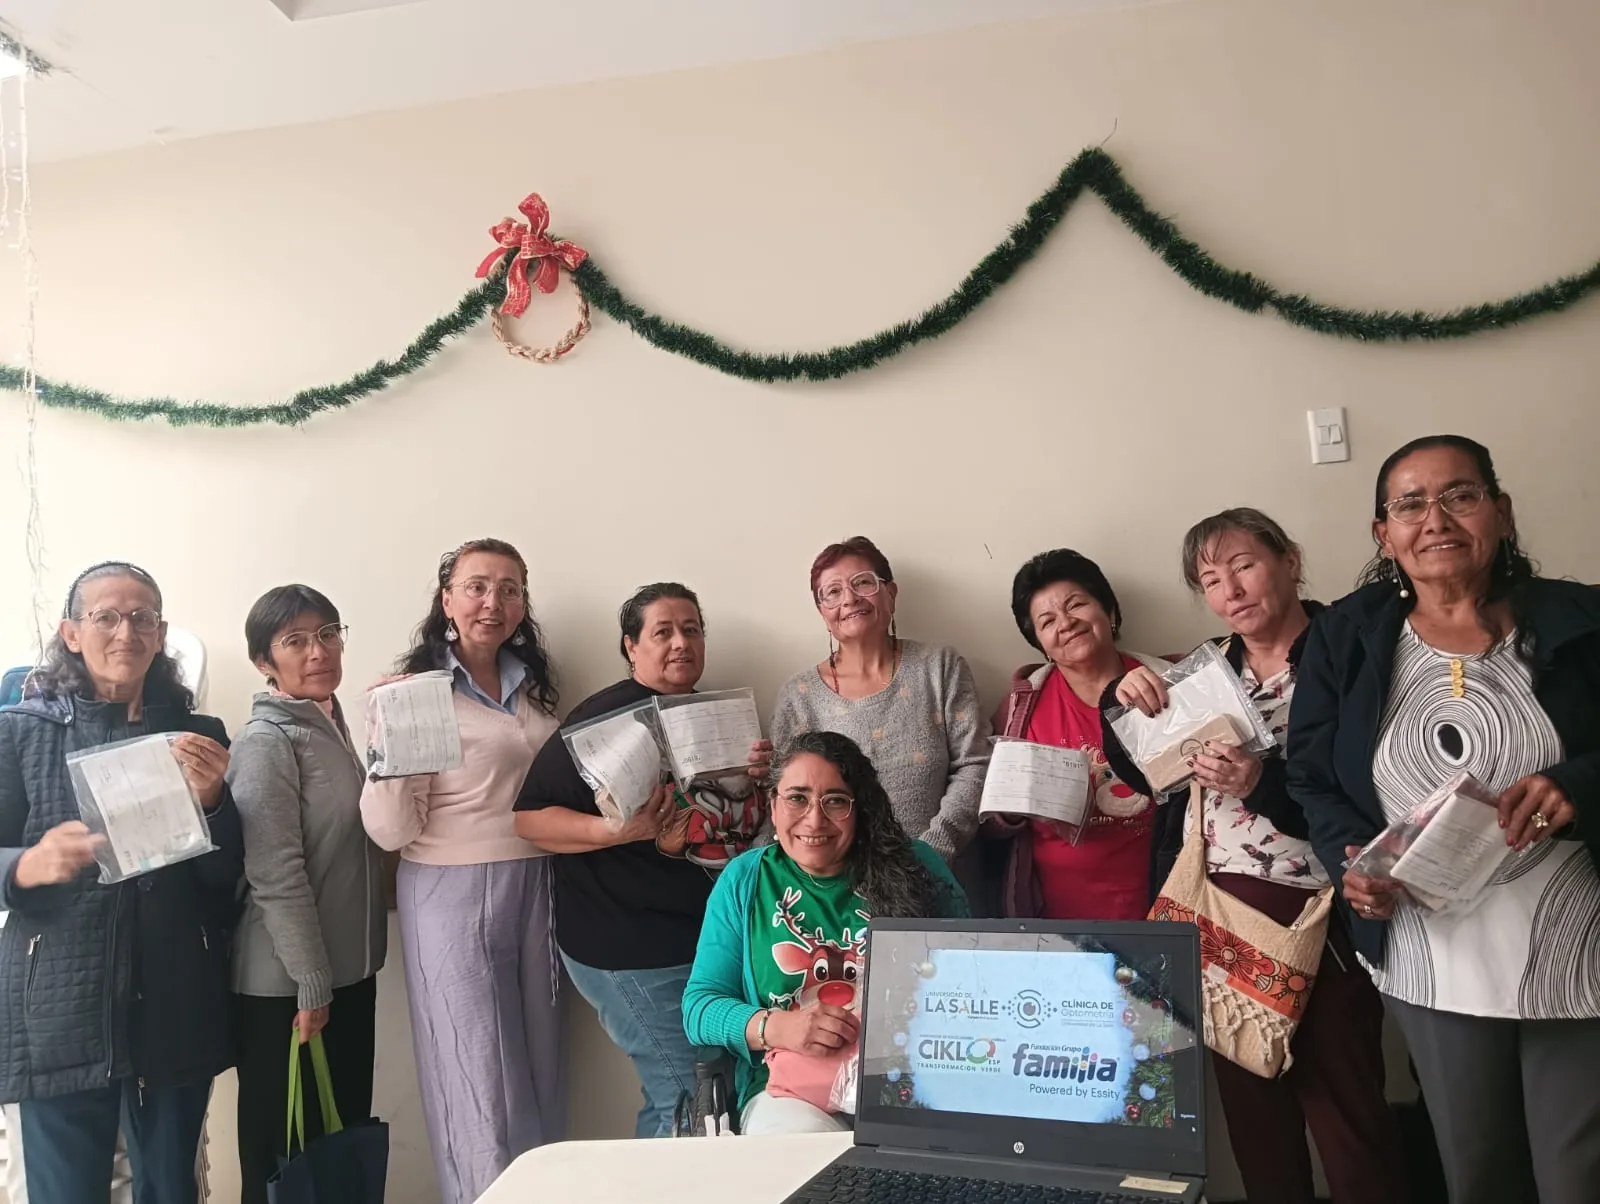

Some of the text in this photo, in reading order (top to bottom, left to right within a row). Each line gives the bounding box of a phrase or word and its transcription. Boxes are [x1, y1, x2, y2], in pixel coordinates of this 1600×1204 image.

[1061, 999, 1114, 1010] CLÍNICA DE
[1061, 1044, 1082, 1053] Grupo
[1012, 1043, 1117, 1083] familia
[1029, 1083, 1120, 1100] Powered by Essity
